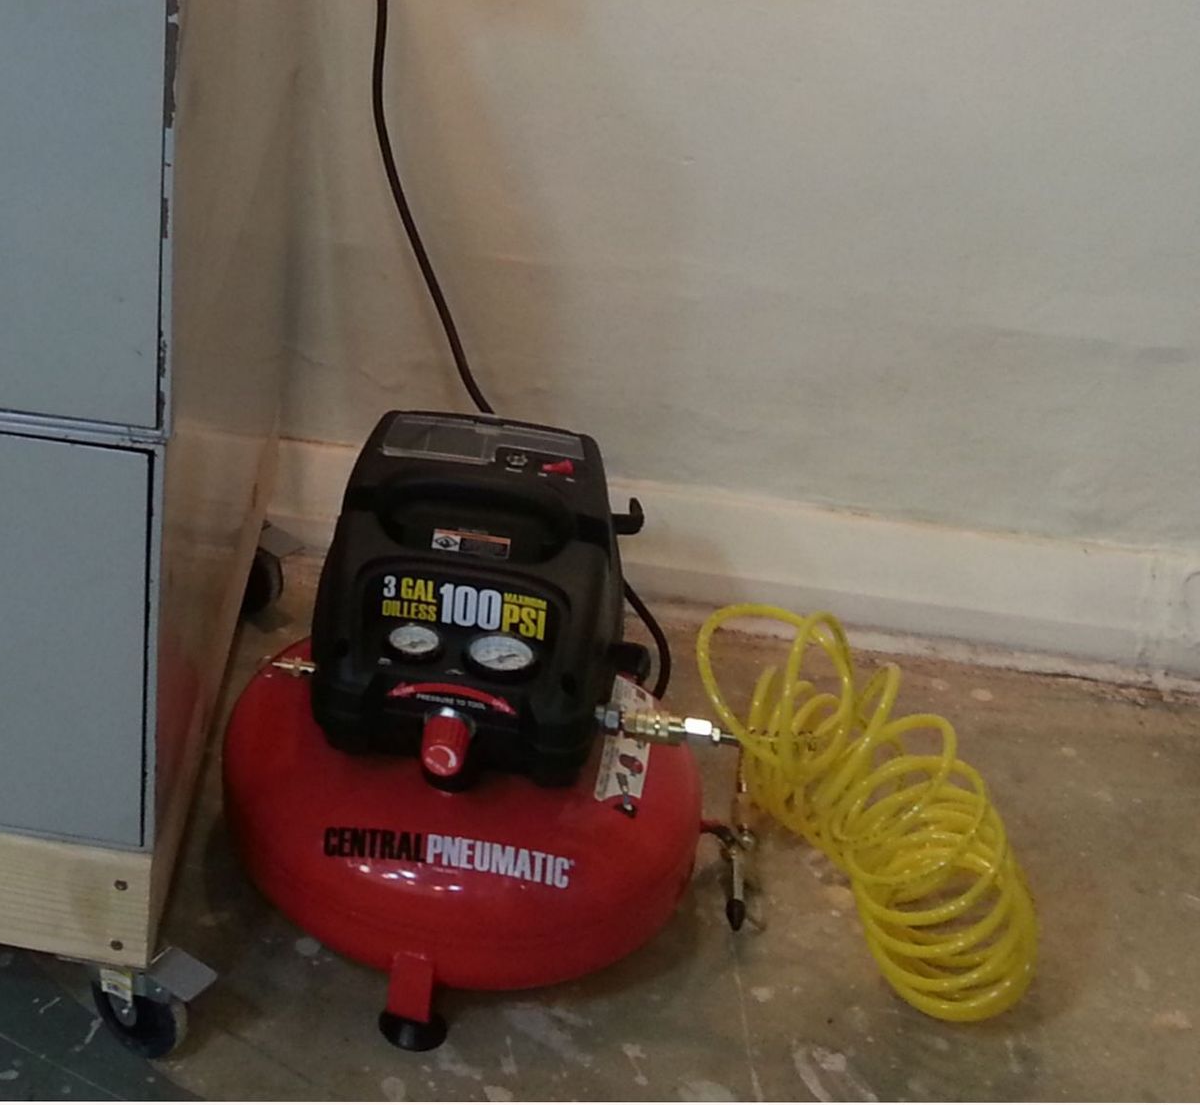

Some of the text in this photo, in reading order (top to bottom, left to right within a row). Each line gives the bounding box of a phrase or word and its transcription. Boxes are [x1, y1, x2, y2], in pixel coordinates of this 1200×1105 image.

[383, 575, 437, 603] 3 GAL
[382, 600, 437, 622] OILLESS
[439, 582, 502, 631] 100
[501, 603, 546, 641] PSI
[415, 693, 455, 705] PRESSURE
[455, 698, 466, 707] TO
